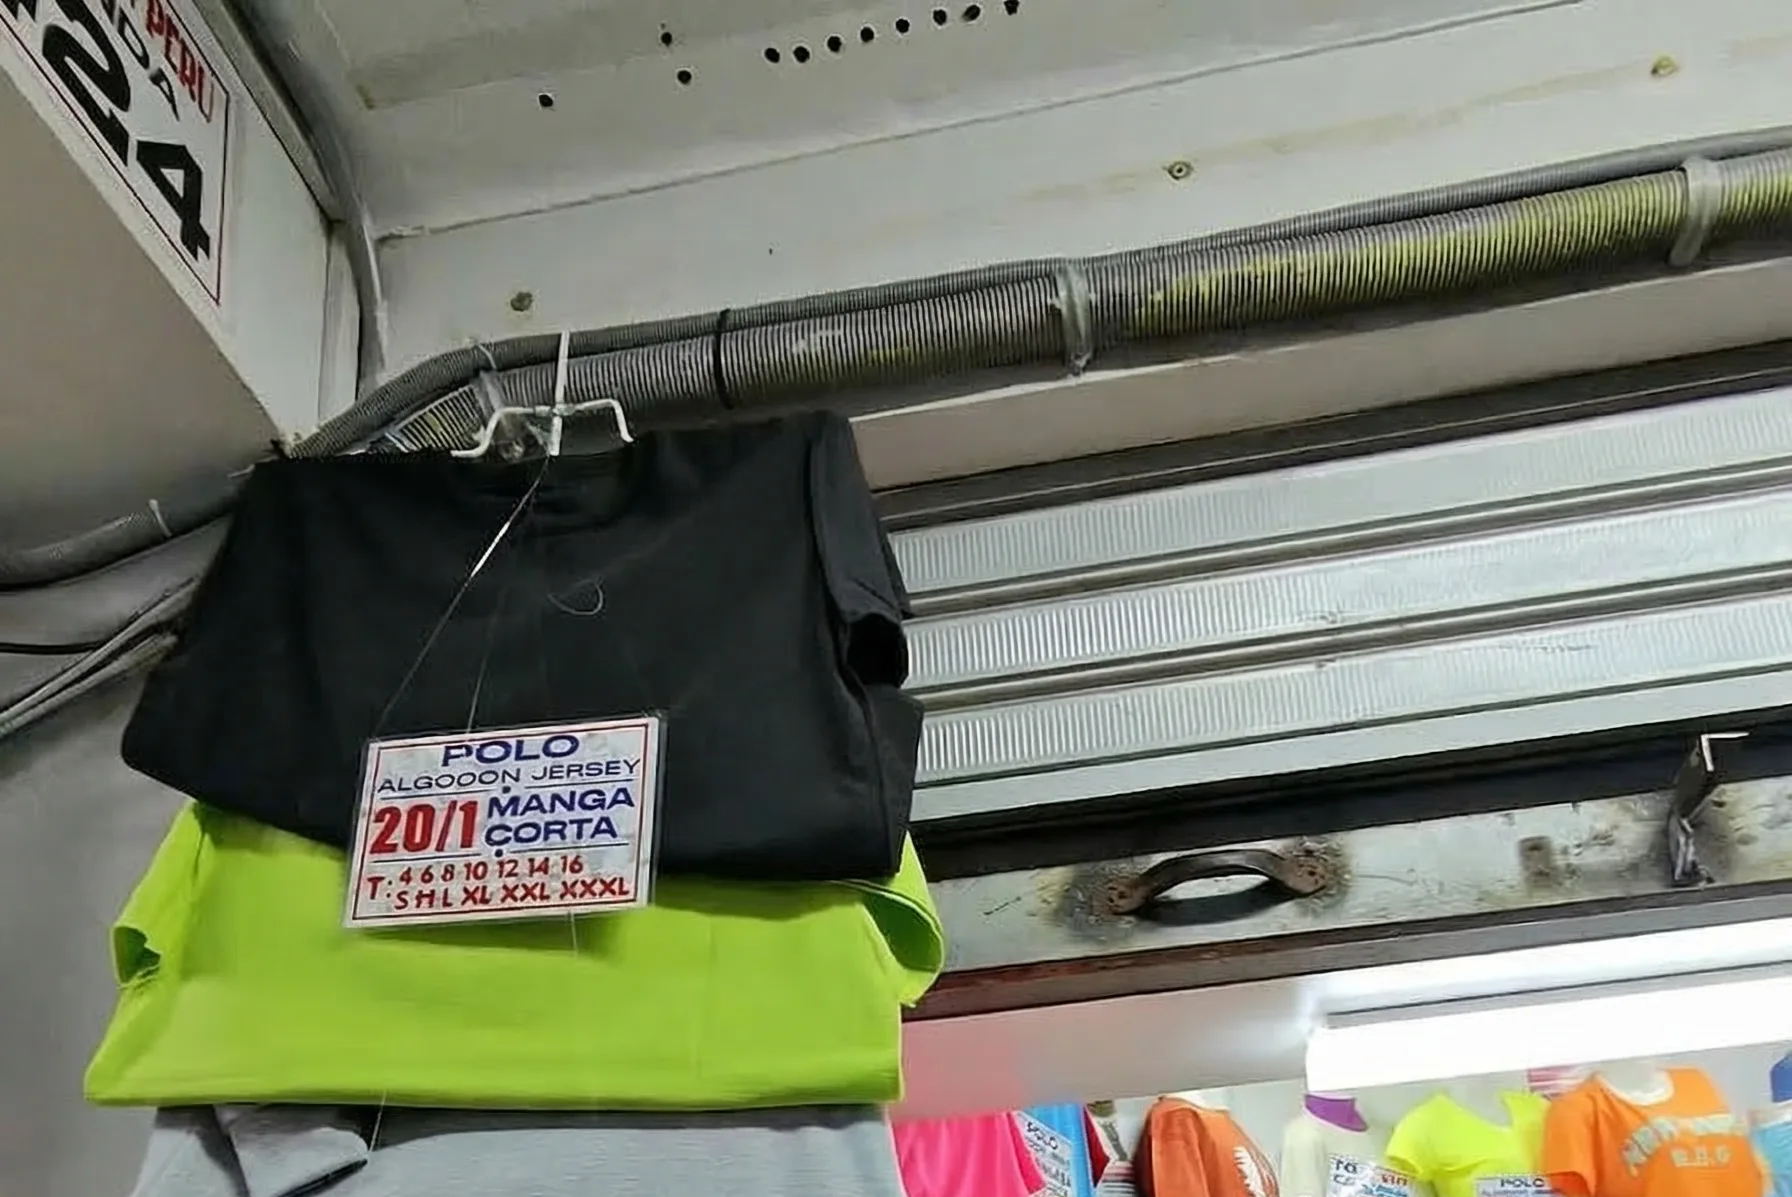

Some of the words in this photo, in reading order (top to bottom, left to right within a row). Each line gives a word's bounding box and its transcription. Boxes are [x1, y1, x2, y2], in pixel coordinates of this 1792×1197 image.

[0, 0, 211, 262] 24
[441, 734, 580, 767] POLO
[531, 758, 641, 781] JERSEY
[369, 800, 478, 855] 20/1
[487, 787, 635, 818] MANGA
[485, 817, 618, 846] CORTA
[399, 866, 412, 885] 4
[421, 865, 434, 884] 6
[441, 863, 455, 882] 8
[464, 861, 488, 880] 10
[497, 859, 519, 878] 12
[528, 857, 549, 877] 14
[561, 855, 584, 874] 16
[394, 890, 409, 910] S
[442, 887, 454, 908] L
[461, 885, 492, 905] XL
[500, 882, 550, 903] XXL
[560, 877, 630, 900] XXXL
